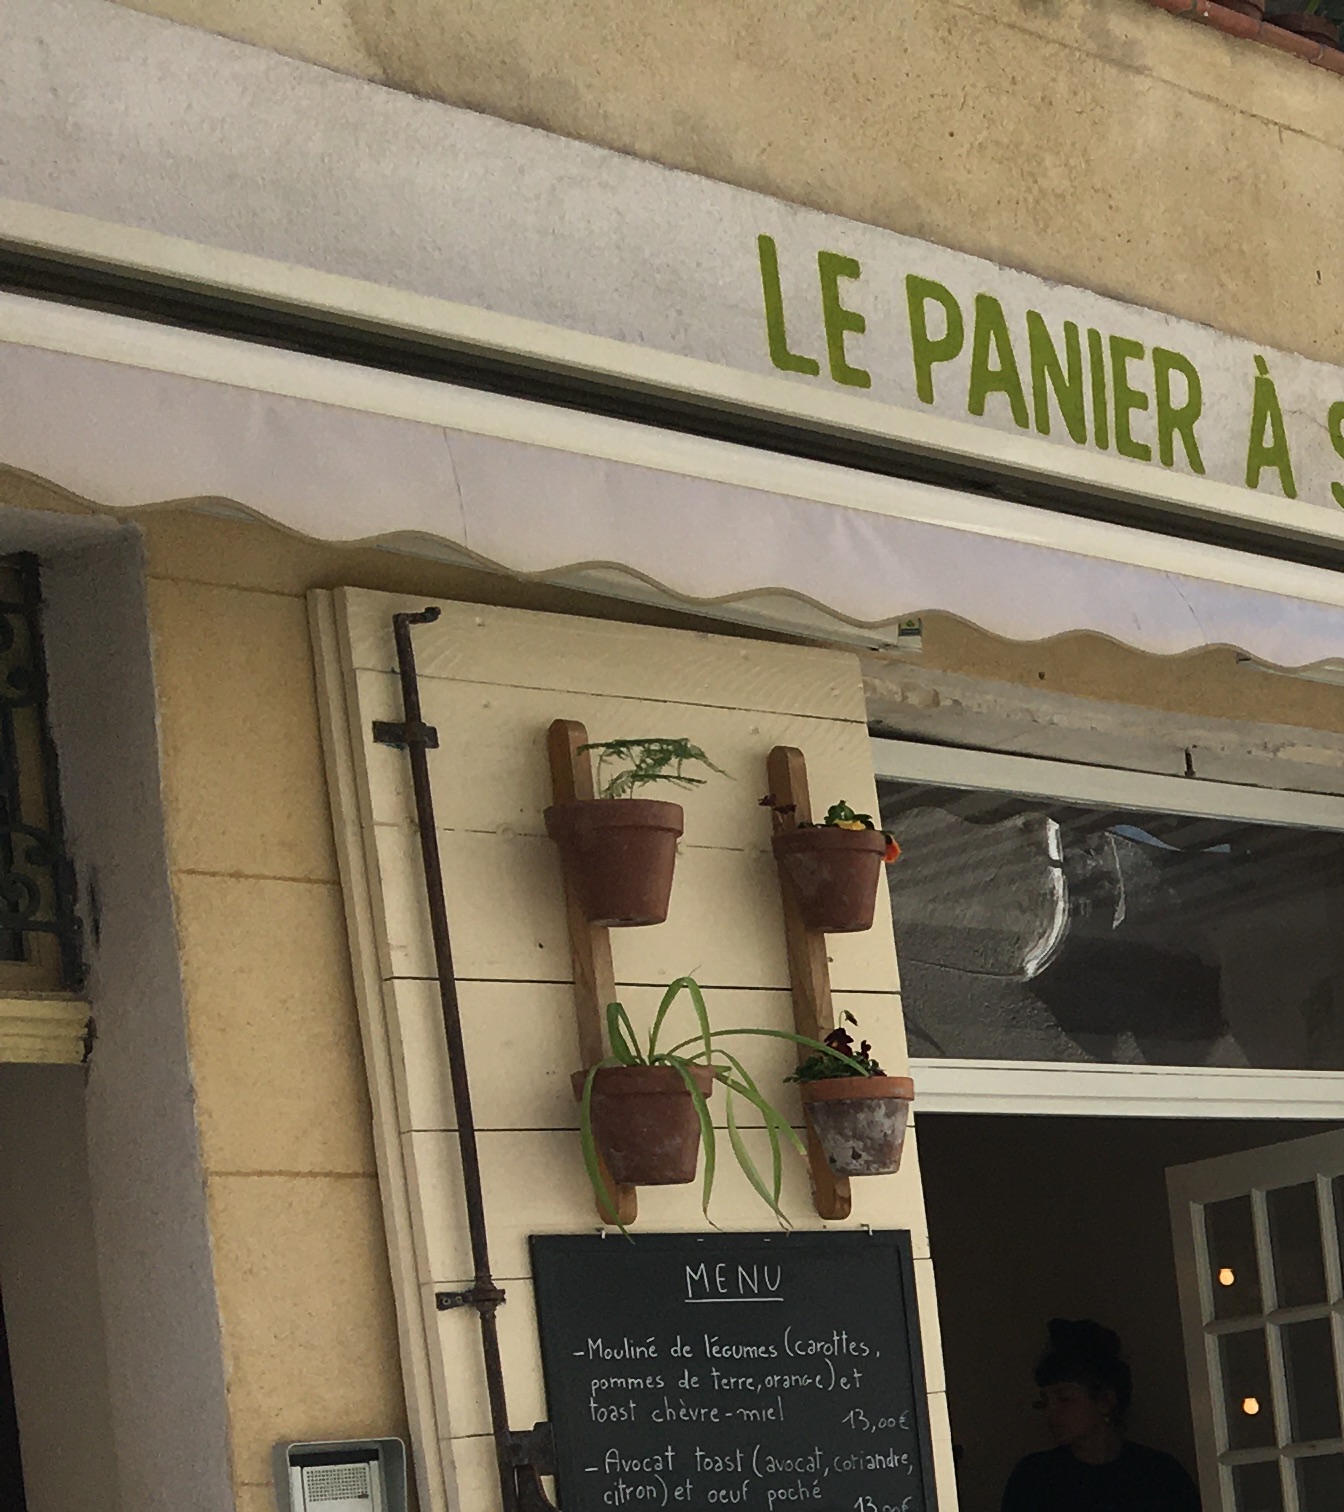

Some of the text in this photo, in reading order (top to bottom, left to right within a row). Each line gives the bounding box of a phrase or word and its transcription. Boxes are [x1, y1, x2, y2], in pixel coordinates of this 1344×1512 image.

[758, 233, 871, 390] LE
[905, 273, 1207, 477] PANIER
[1245, 353, 1298, 500] À
[685, 1263, 782, 1298] MENU
[670, 1334, 692, 1358] de
[784, 1326, 881, 1358] (carottes,
[591, 1375, 665, 1397] pommes
[678, 1369, 700, 1389] de
[840, 1369, 863, 1389] et
[589, 1398, 636, 1422] toast
[841, 1408, 910, 1432] 13,00€
[695, 1446, 744, 1472] toast
[603, 1474, 822, 1511] citron) et oeuf poché
